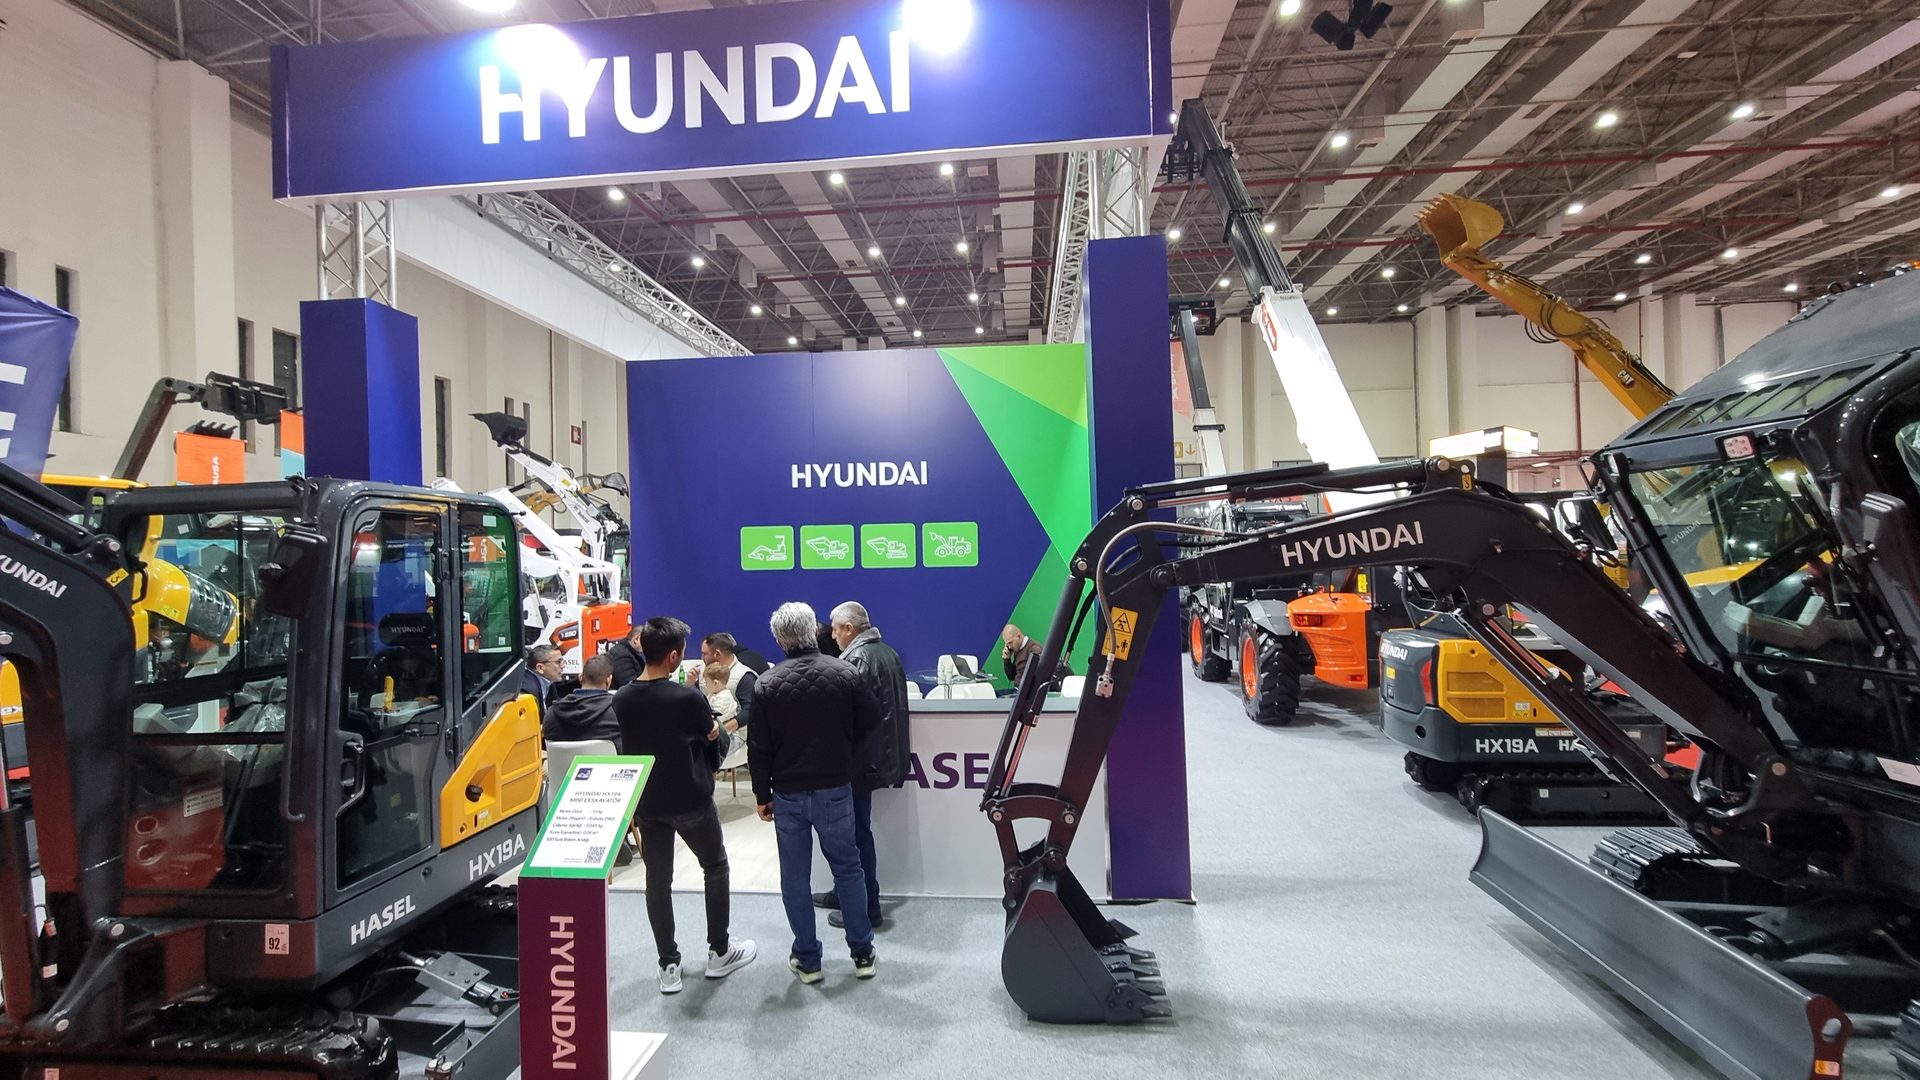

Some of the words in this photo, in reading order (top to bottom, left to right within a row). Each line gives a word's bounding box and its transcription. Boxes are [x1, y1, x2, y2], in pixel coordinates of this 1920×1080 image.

[480, 30, 911, 145] HYUNDAI
[1617, 370, 1634, 385] CAT
[791, 461, 928, 488] HYUNDAI
[1281, 521, 1424, 567] HYUNDAI
[1476, 738, 1539, 754] HX19A
[903, 752, 990, 790] ASE
[469, 833, 526, 881] HX19A
[351, 894, 416, 946] HASEL
[268, 937, 280, 950] 92
[550, 915, 577, 1070] HYUNDAI
